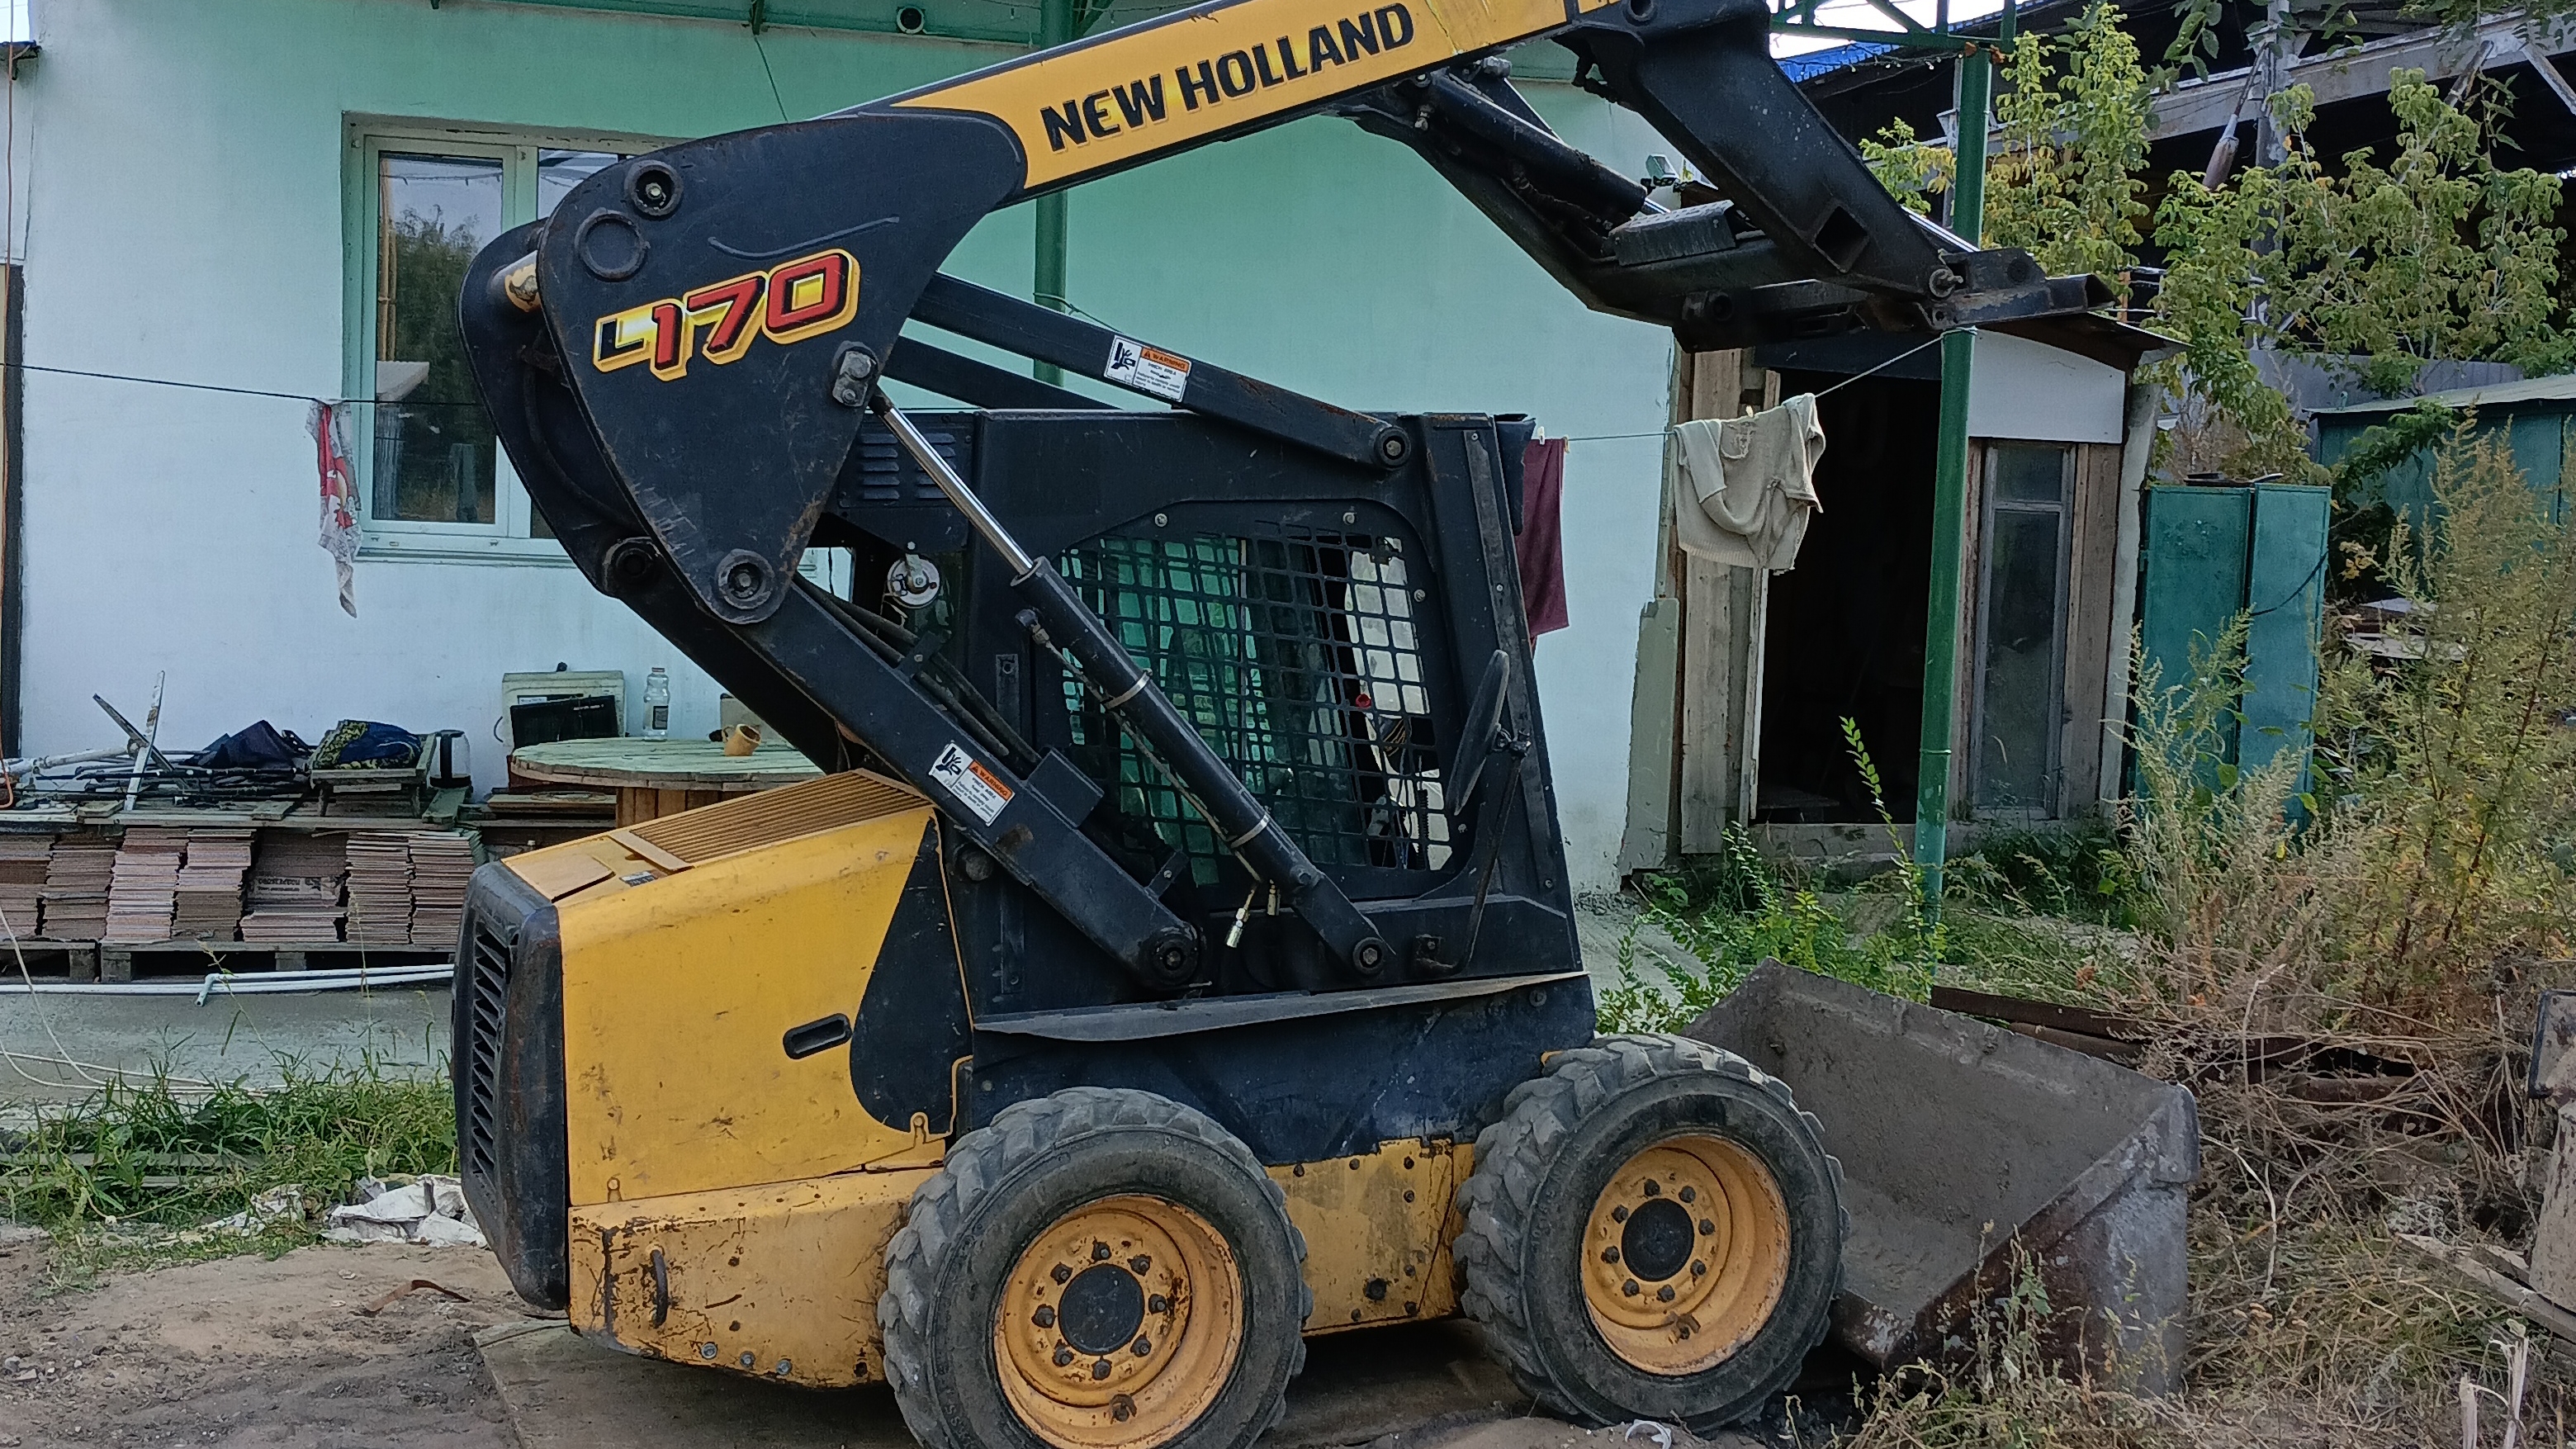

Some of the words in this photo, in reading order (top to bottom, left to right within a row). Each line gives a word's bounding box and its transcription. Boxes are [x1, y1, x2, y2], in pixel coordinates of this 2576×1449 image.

[1039, 75, 1167, 152] NEW
[1175, 2, 1414, 111] HOLLAND
[594, 249, 857, 378] L170
[1152, 353, 1186, 369] WARNING
[979, 769, 1008, 796] WARNING
